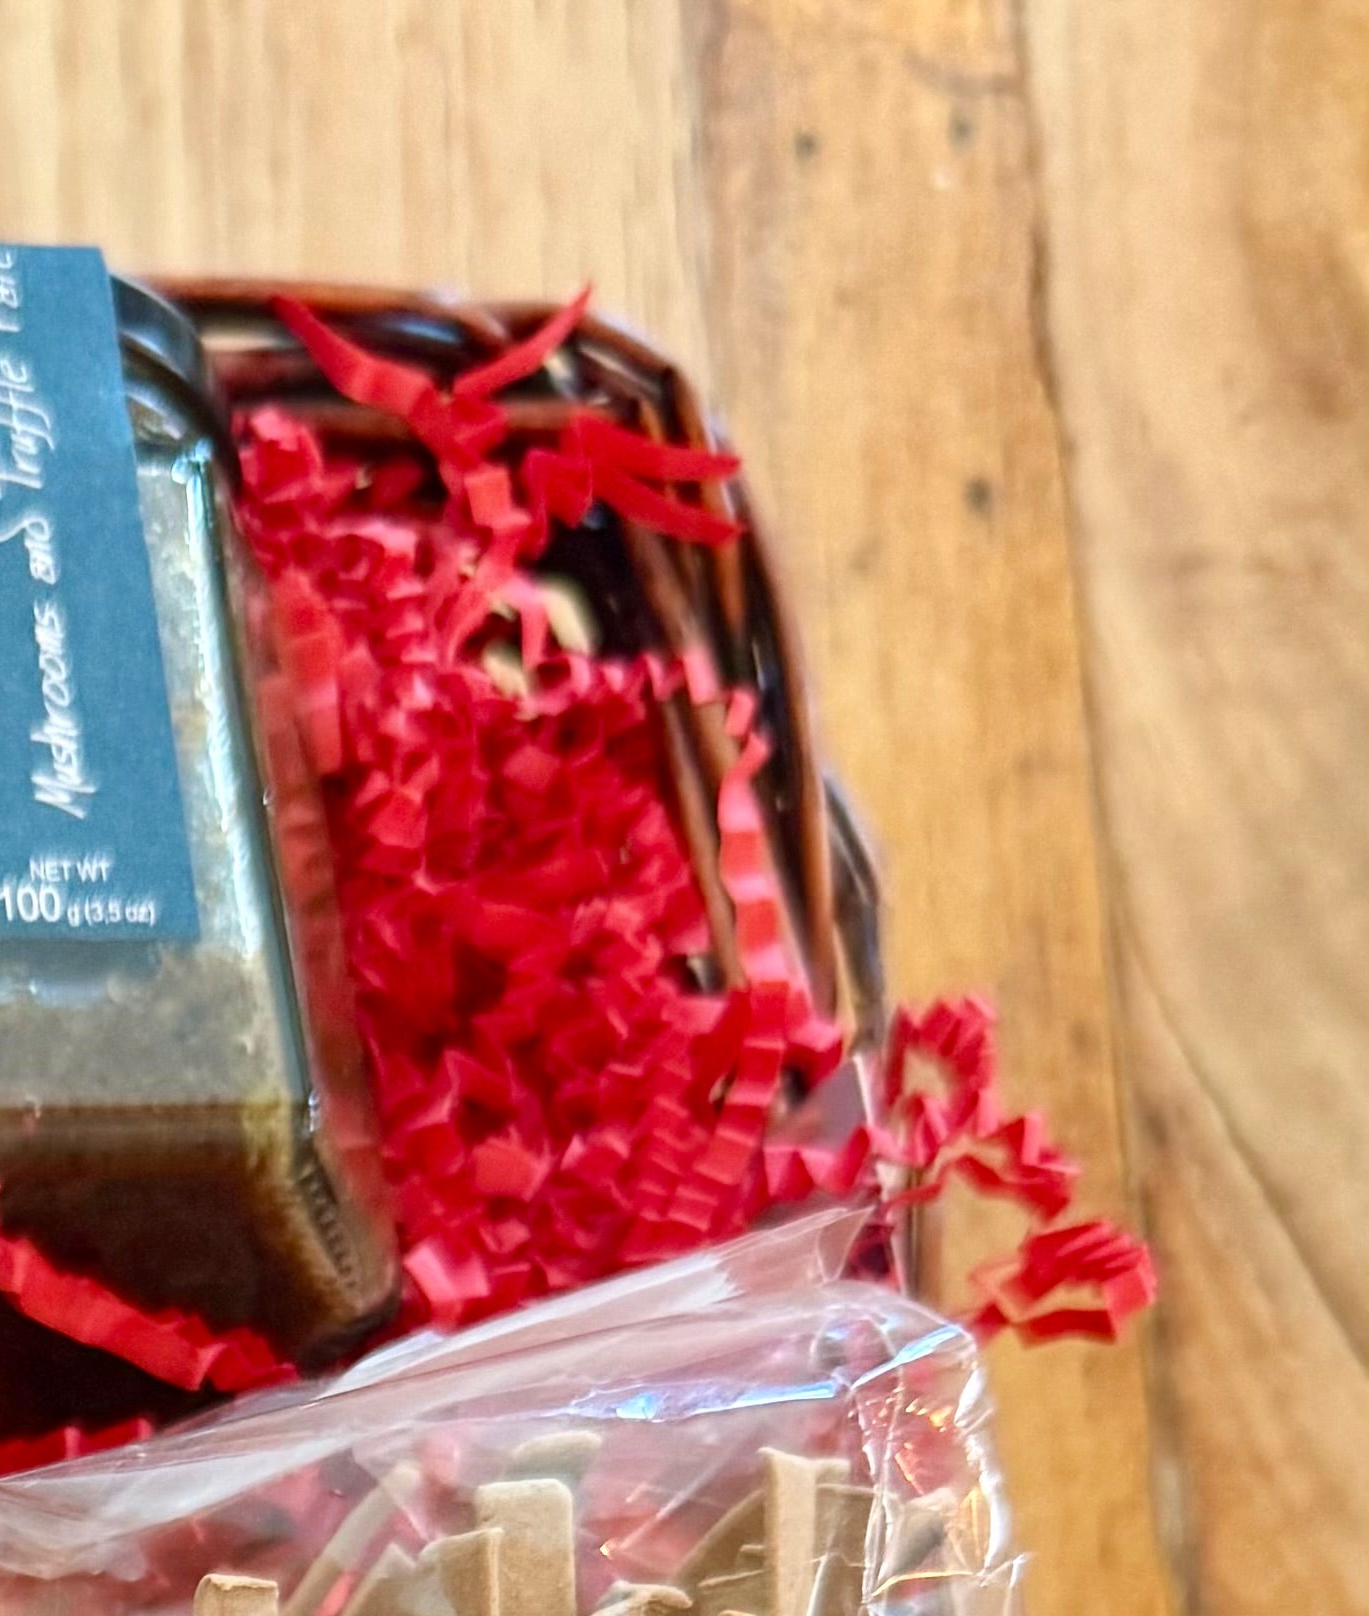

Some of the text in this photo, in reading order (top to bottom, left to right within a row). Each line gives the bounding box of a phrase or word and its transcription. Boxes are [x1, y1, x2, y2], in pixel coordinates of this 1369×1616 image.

[31, 598, 98, 820] Mushrooms
[28, 855, 111, 882] NET WT
